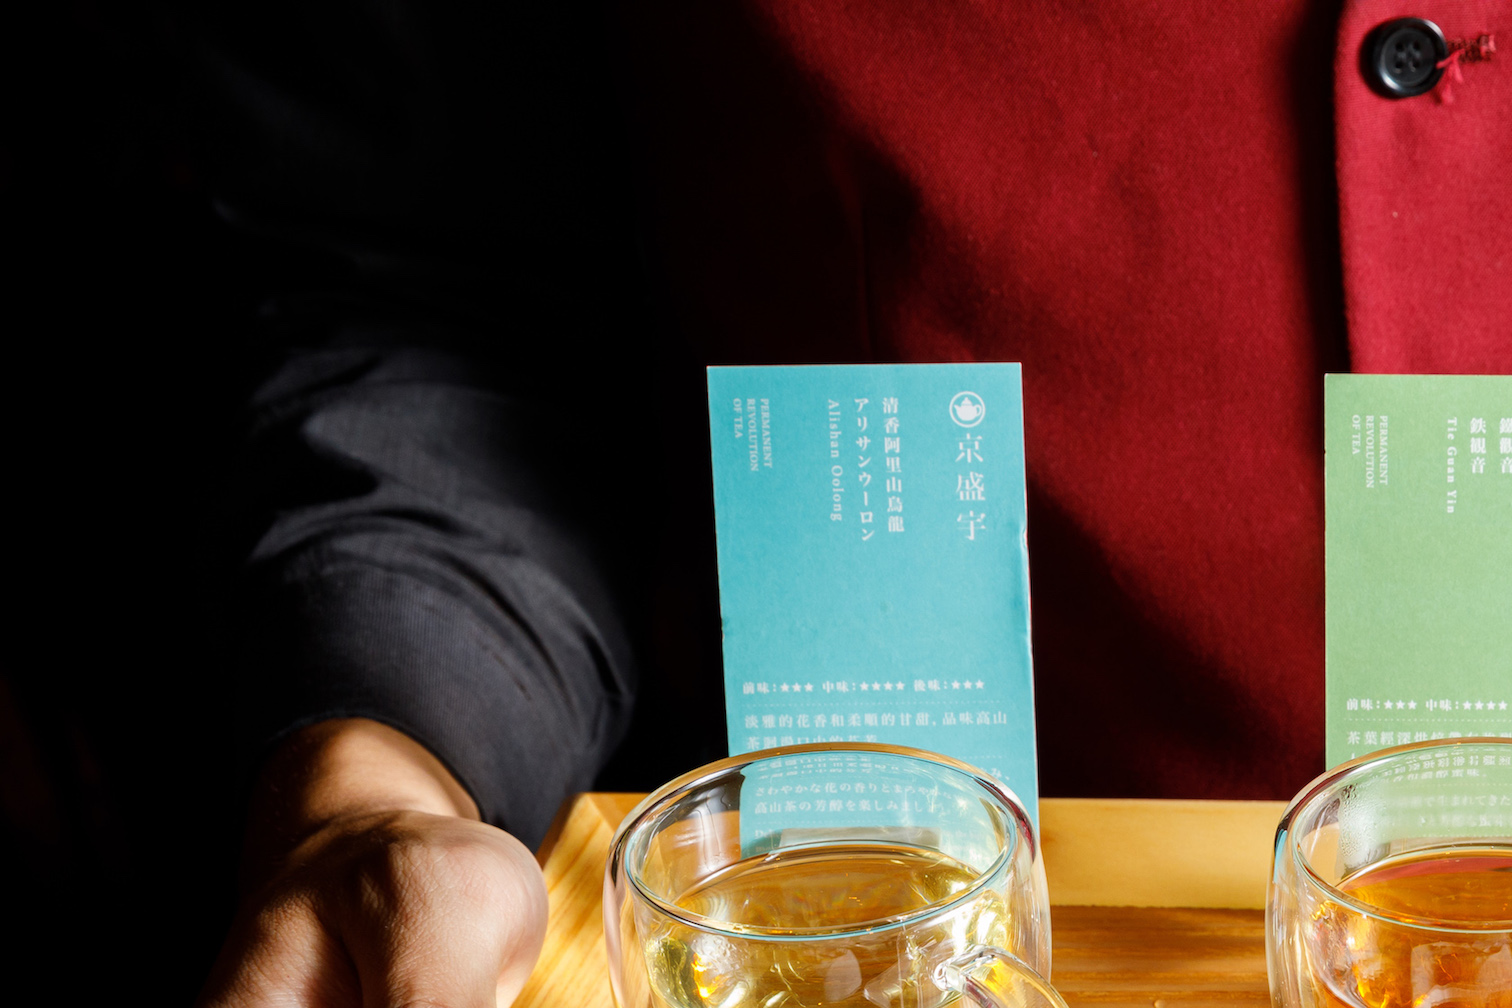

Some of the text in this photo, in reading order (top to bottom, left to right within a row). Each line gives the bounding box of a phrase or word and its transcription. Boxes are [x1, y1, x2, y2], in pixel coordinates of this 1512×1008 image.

[732, 397, 744, 439] OF TEA
[746, 397, 759, 472] REVOLUTION
[760, 398, 773, 469] PERMANENT
[1351, 414, 1361, 455] OF TEA
[1365, 415, 1375, 489] REVOLUTION
[1379, 415, 1389, 485] PERMANENT
[827, 399, 845, 522] Alishan Oolong
[854, 397, 875, 542] アリサンウーロン
[882, 396, 905, 533] 清香阿里山烏龍
[955, 432, 986, 541] 京盛宇
[1446, 417, 1458, 514] Tie Guan Yin
